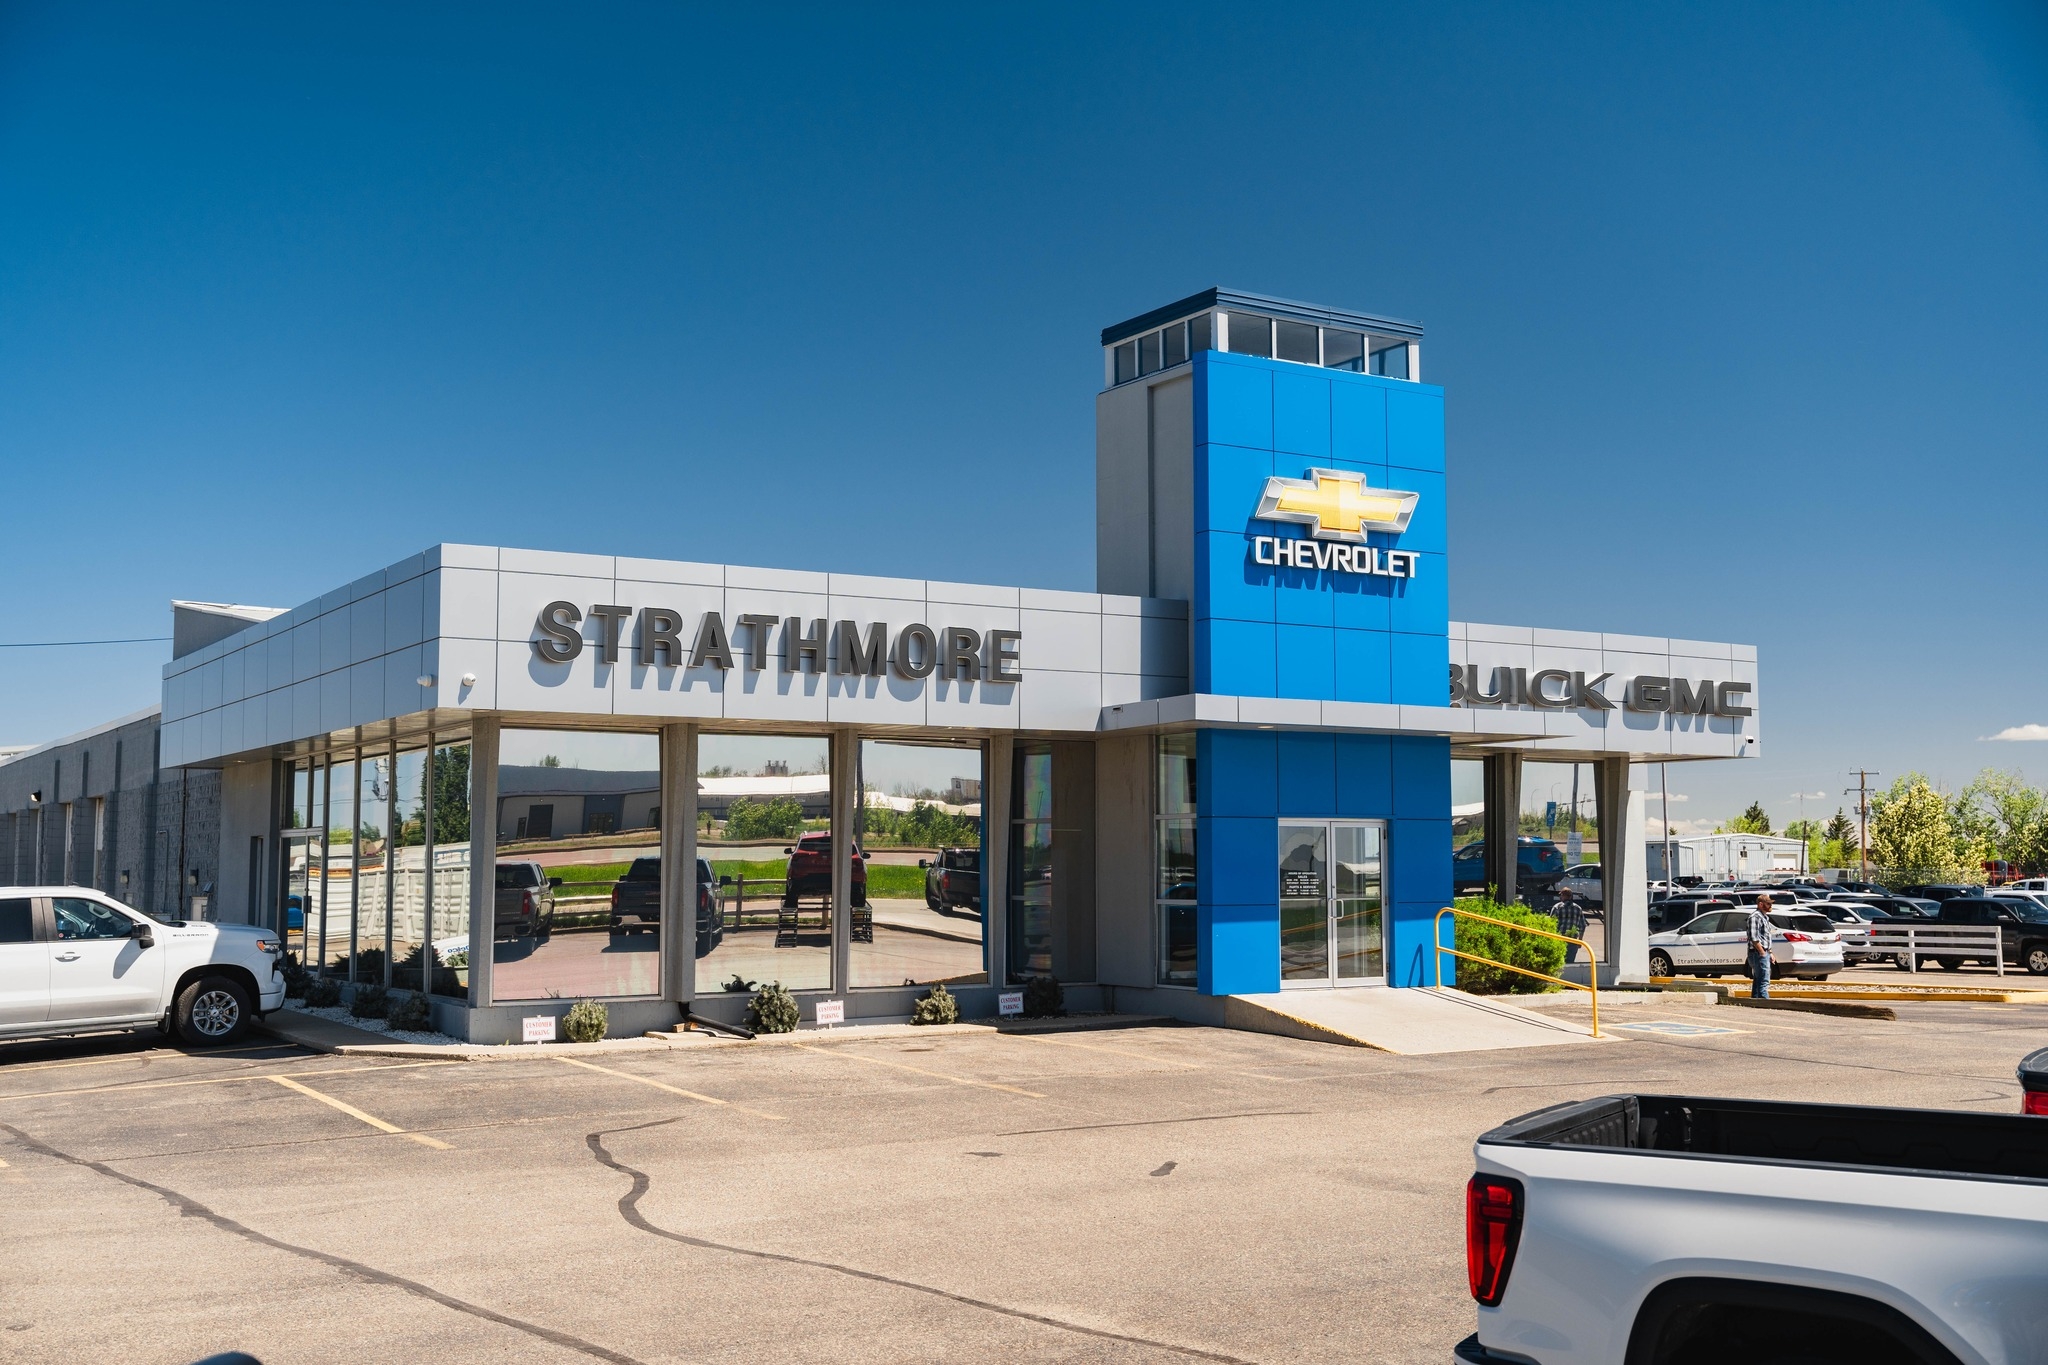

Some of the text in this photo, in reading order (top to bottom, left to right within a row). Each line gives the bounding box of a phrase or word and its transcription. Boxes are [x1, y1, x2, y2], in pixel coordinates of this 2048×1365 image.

[1253, 536, 1421, 578] CHEVROLET
[537, 600, 1022, 683] STRATHMORE
[1628, 675, 1752, 717] GMC
[1677, 957, 1743, 965] StrathmoreMotors.com
[525, 1021, 553, 1029] CUSTOMER
[528, 1029, 550, 1037] PARKING
